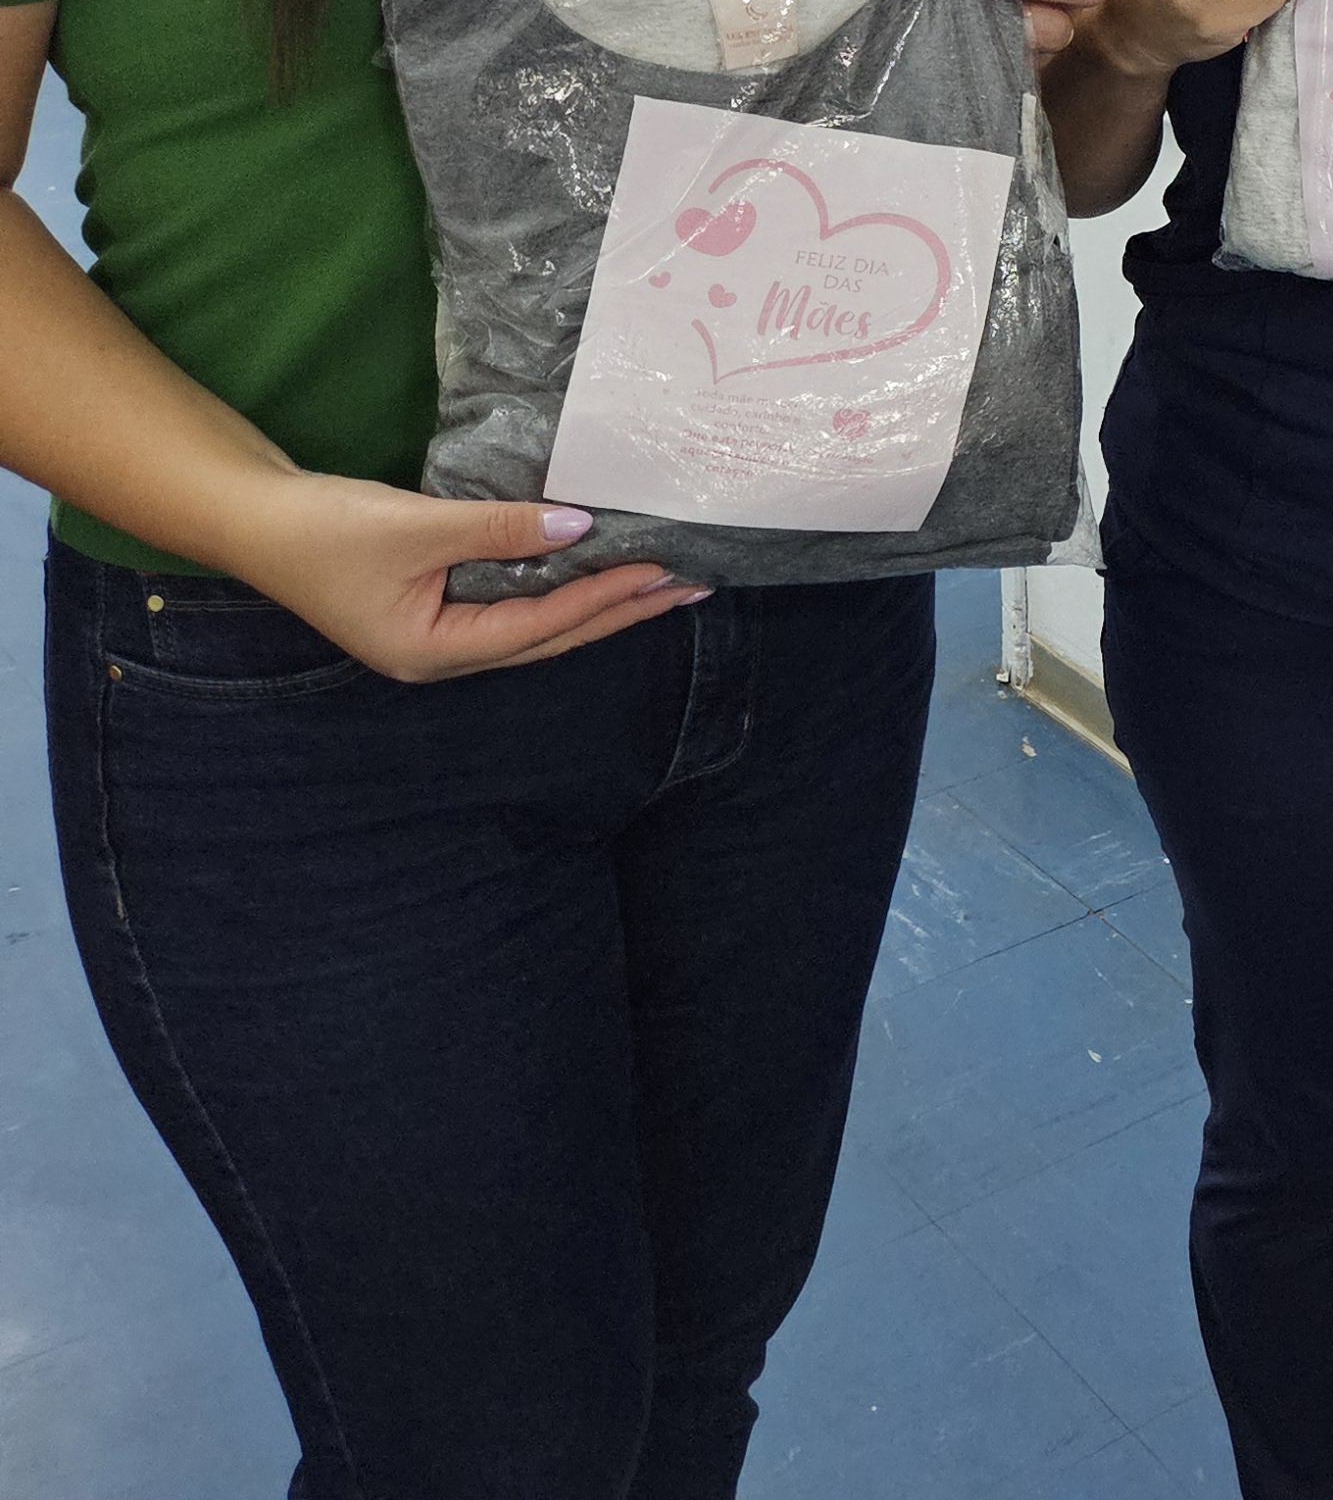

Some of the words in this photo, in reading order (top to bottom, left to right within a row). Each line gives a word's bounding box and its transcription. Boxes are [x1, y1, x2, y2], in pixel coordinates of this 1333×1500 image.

[796, 250, 846, 270] FELIZ
[853, 258, 889, 276] DIA
[824, 274, 863, 293] DAS
[757, 280, 872, 340] Mães
